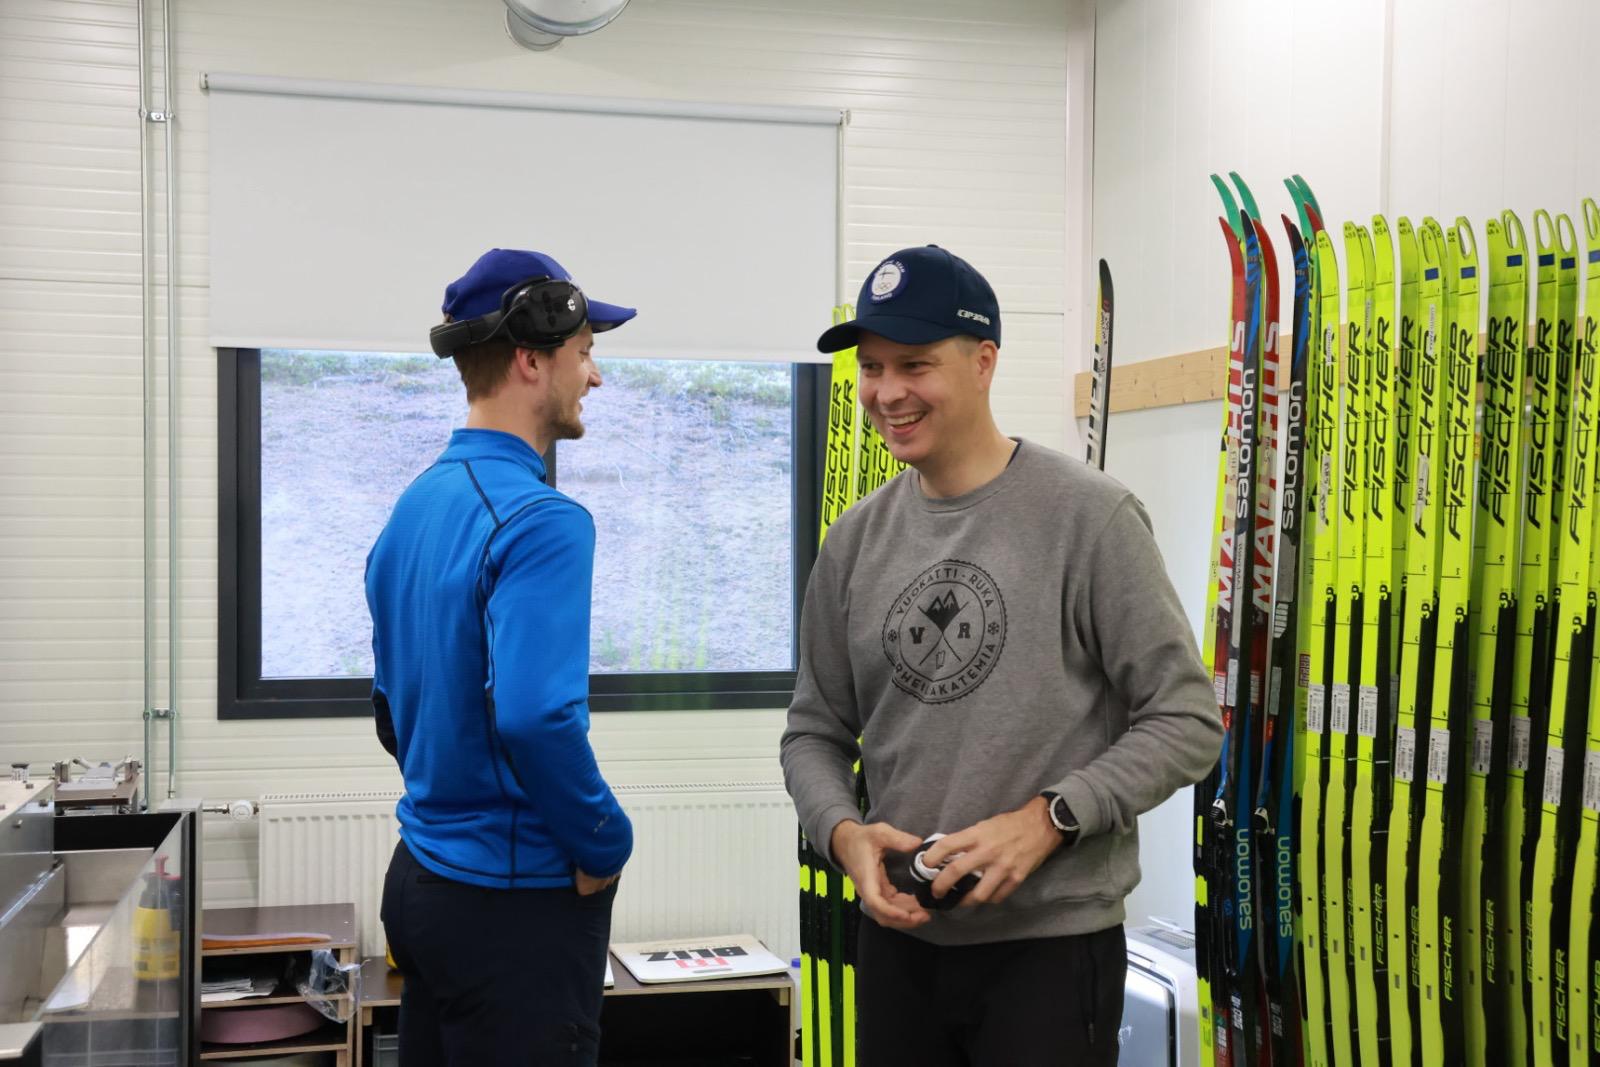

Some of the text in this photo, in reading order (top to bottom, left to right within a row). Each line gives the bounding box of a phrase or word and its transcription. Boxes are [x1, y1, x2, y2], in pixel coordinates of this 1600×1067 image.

[824, 382, 841, 526] FISCHER
[1237, 369, 1254, 519] salomon
[1282, 381, 1302, 530] salomon
[1344, 322, 1360, 523] FISCHER
[1371, 316, 1389, 521] FISCHER
[1394, 315, 1414, 514] FISCHER
[1449, 329, 1472, 541] FISCHER
[1479, 316, 1501, 512] FISCHER
[1493, 316, 1518, 527] FISCHER
[1528, 318, 1552, 529] FISCHER
[1569, 316, 1597, 545] FISCHER
[909, 622, 971, 645] V R
[1236, 828, 1252, 930] salomon
[1278, 836, 1293, 938] salomon
[1375, 883, 1385, 965] FISCHER
[1411, 905, 1420, 988] FISCHER
[1486, 900, 1495, 984] FISCHER
[1444, 915, 1452, 1001] FISCHER
[1556, 949, 1567, 1041] FISCHER
